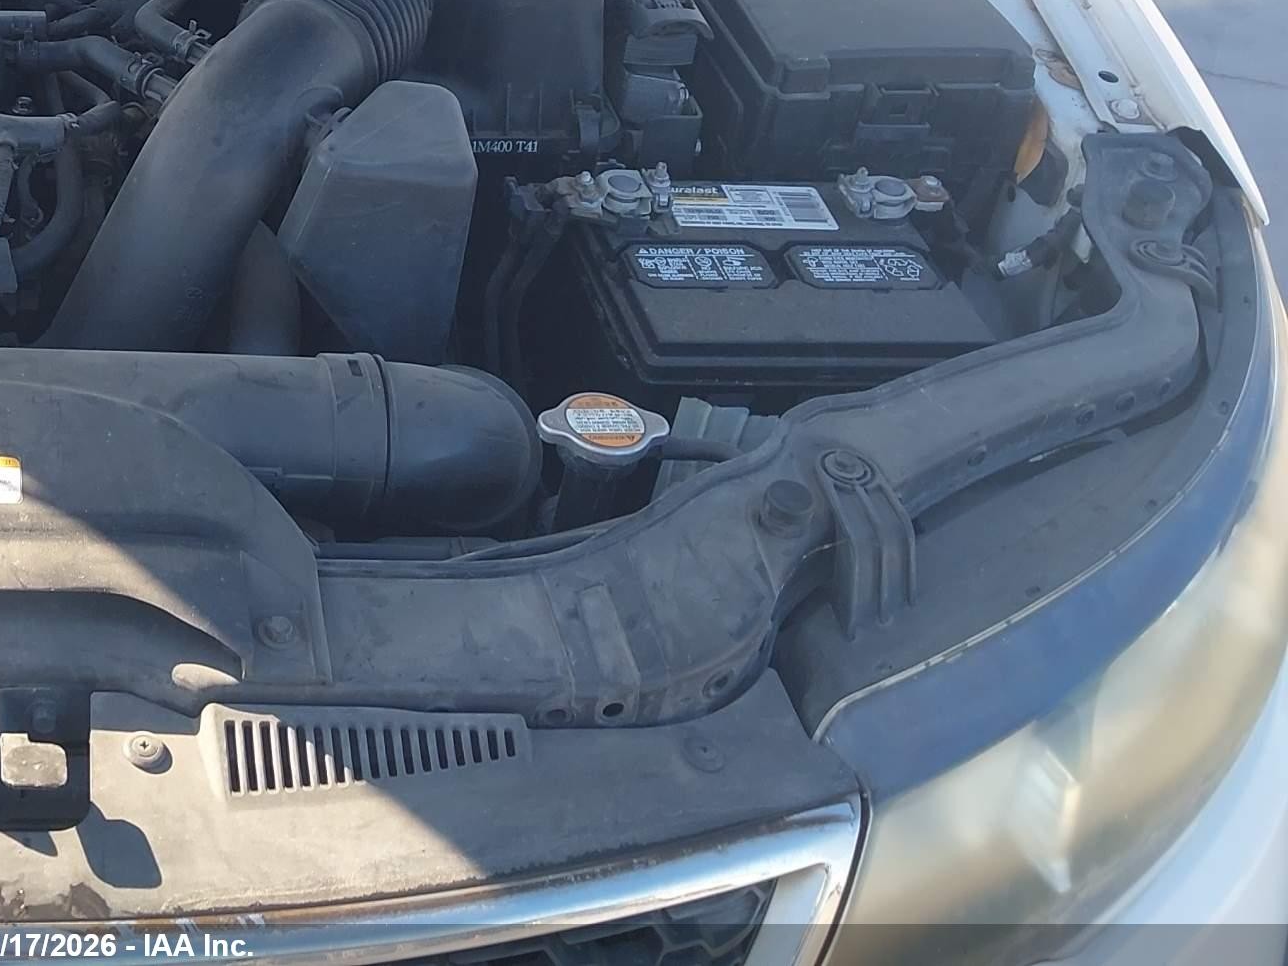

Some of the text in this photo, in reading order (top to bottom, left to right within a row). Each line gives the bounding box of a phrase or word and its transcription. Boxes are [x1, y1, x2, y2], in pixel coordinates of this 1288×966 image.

[670, 186, 719, 195] uralast
[648, 247, 694, 255] DANGER
[704, 247, 745, 255] POISON
